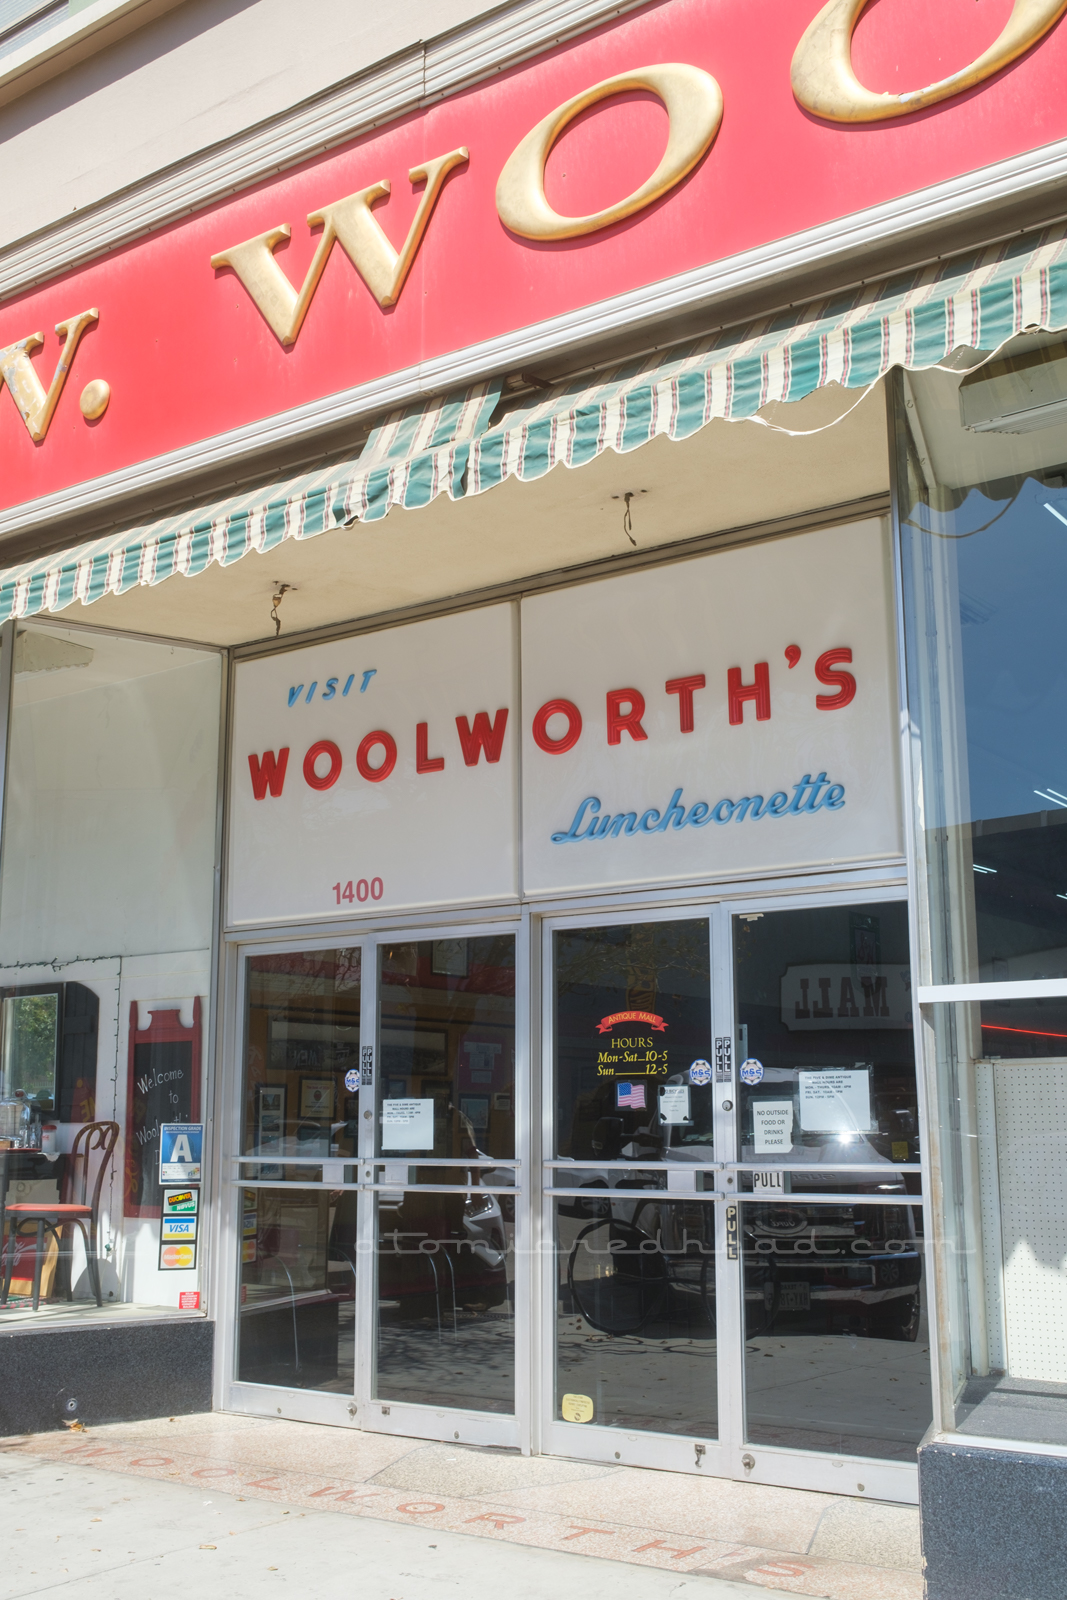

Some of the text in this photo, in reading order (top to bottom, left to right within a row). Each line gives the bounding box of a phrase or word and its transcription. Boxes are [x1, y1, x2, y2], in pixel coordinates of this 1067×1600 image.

[287, 668, 378, 708] VISIT
[247, 643, 857, 801] WOOLWORTH'S
[550, 772, 846, 845] Luncheonette
[332, 876, 384, 905] 1400
[608, 1012, 656, 1024] ANTIQUE MALL
[611, 1036, 653, 1049] HOURS
[137, 1068, 184, 1095] Welcome
[169, 1091, 179, 1104] to
[170, 1134, 193, 1163] A
[753, 1172, 782, 1188] PULL
[169, 1224, 189, 1233] VISA
[727, 1207, 737, 1259] PULL
